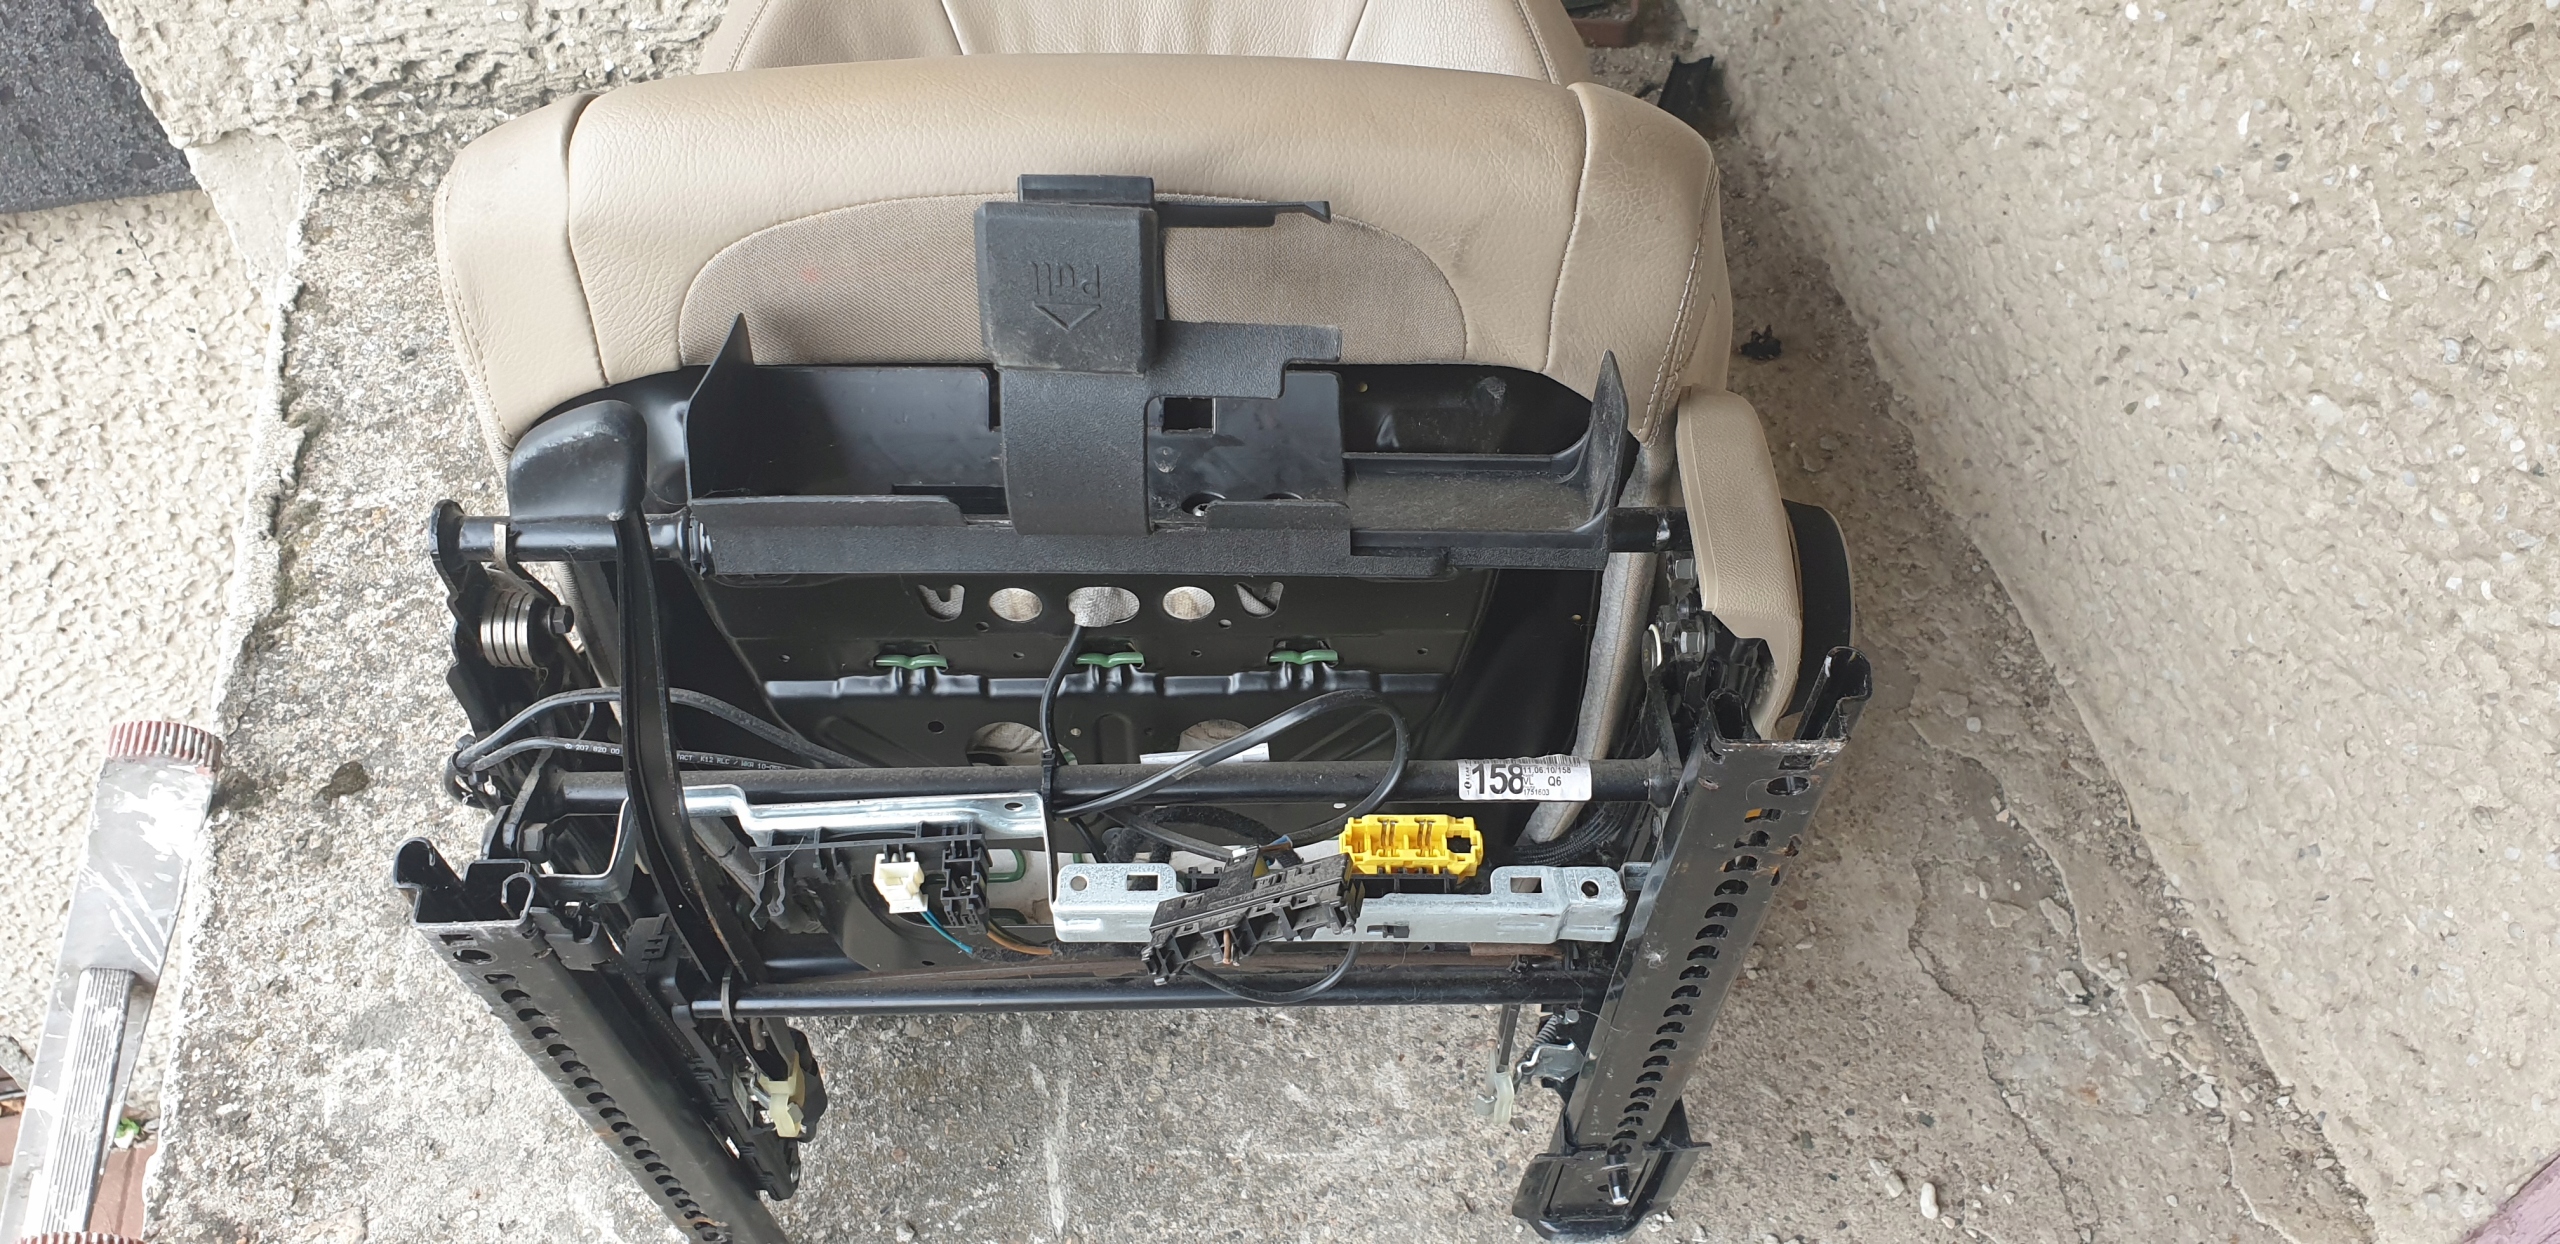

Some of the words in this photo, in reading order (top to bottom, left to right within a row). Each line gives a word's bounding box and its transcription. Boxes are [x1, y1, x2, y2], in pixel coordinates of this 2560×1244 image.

[1030, 261, 1100, 298] Pull
[700, 754, 714, 763] K12
[1472, 763, 1524, 794] 158
[1524, 776, 1533, 785] VL
[1548, 776, 1562, 786] Q6
